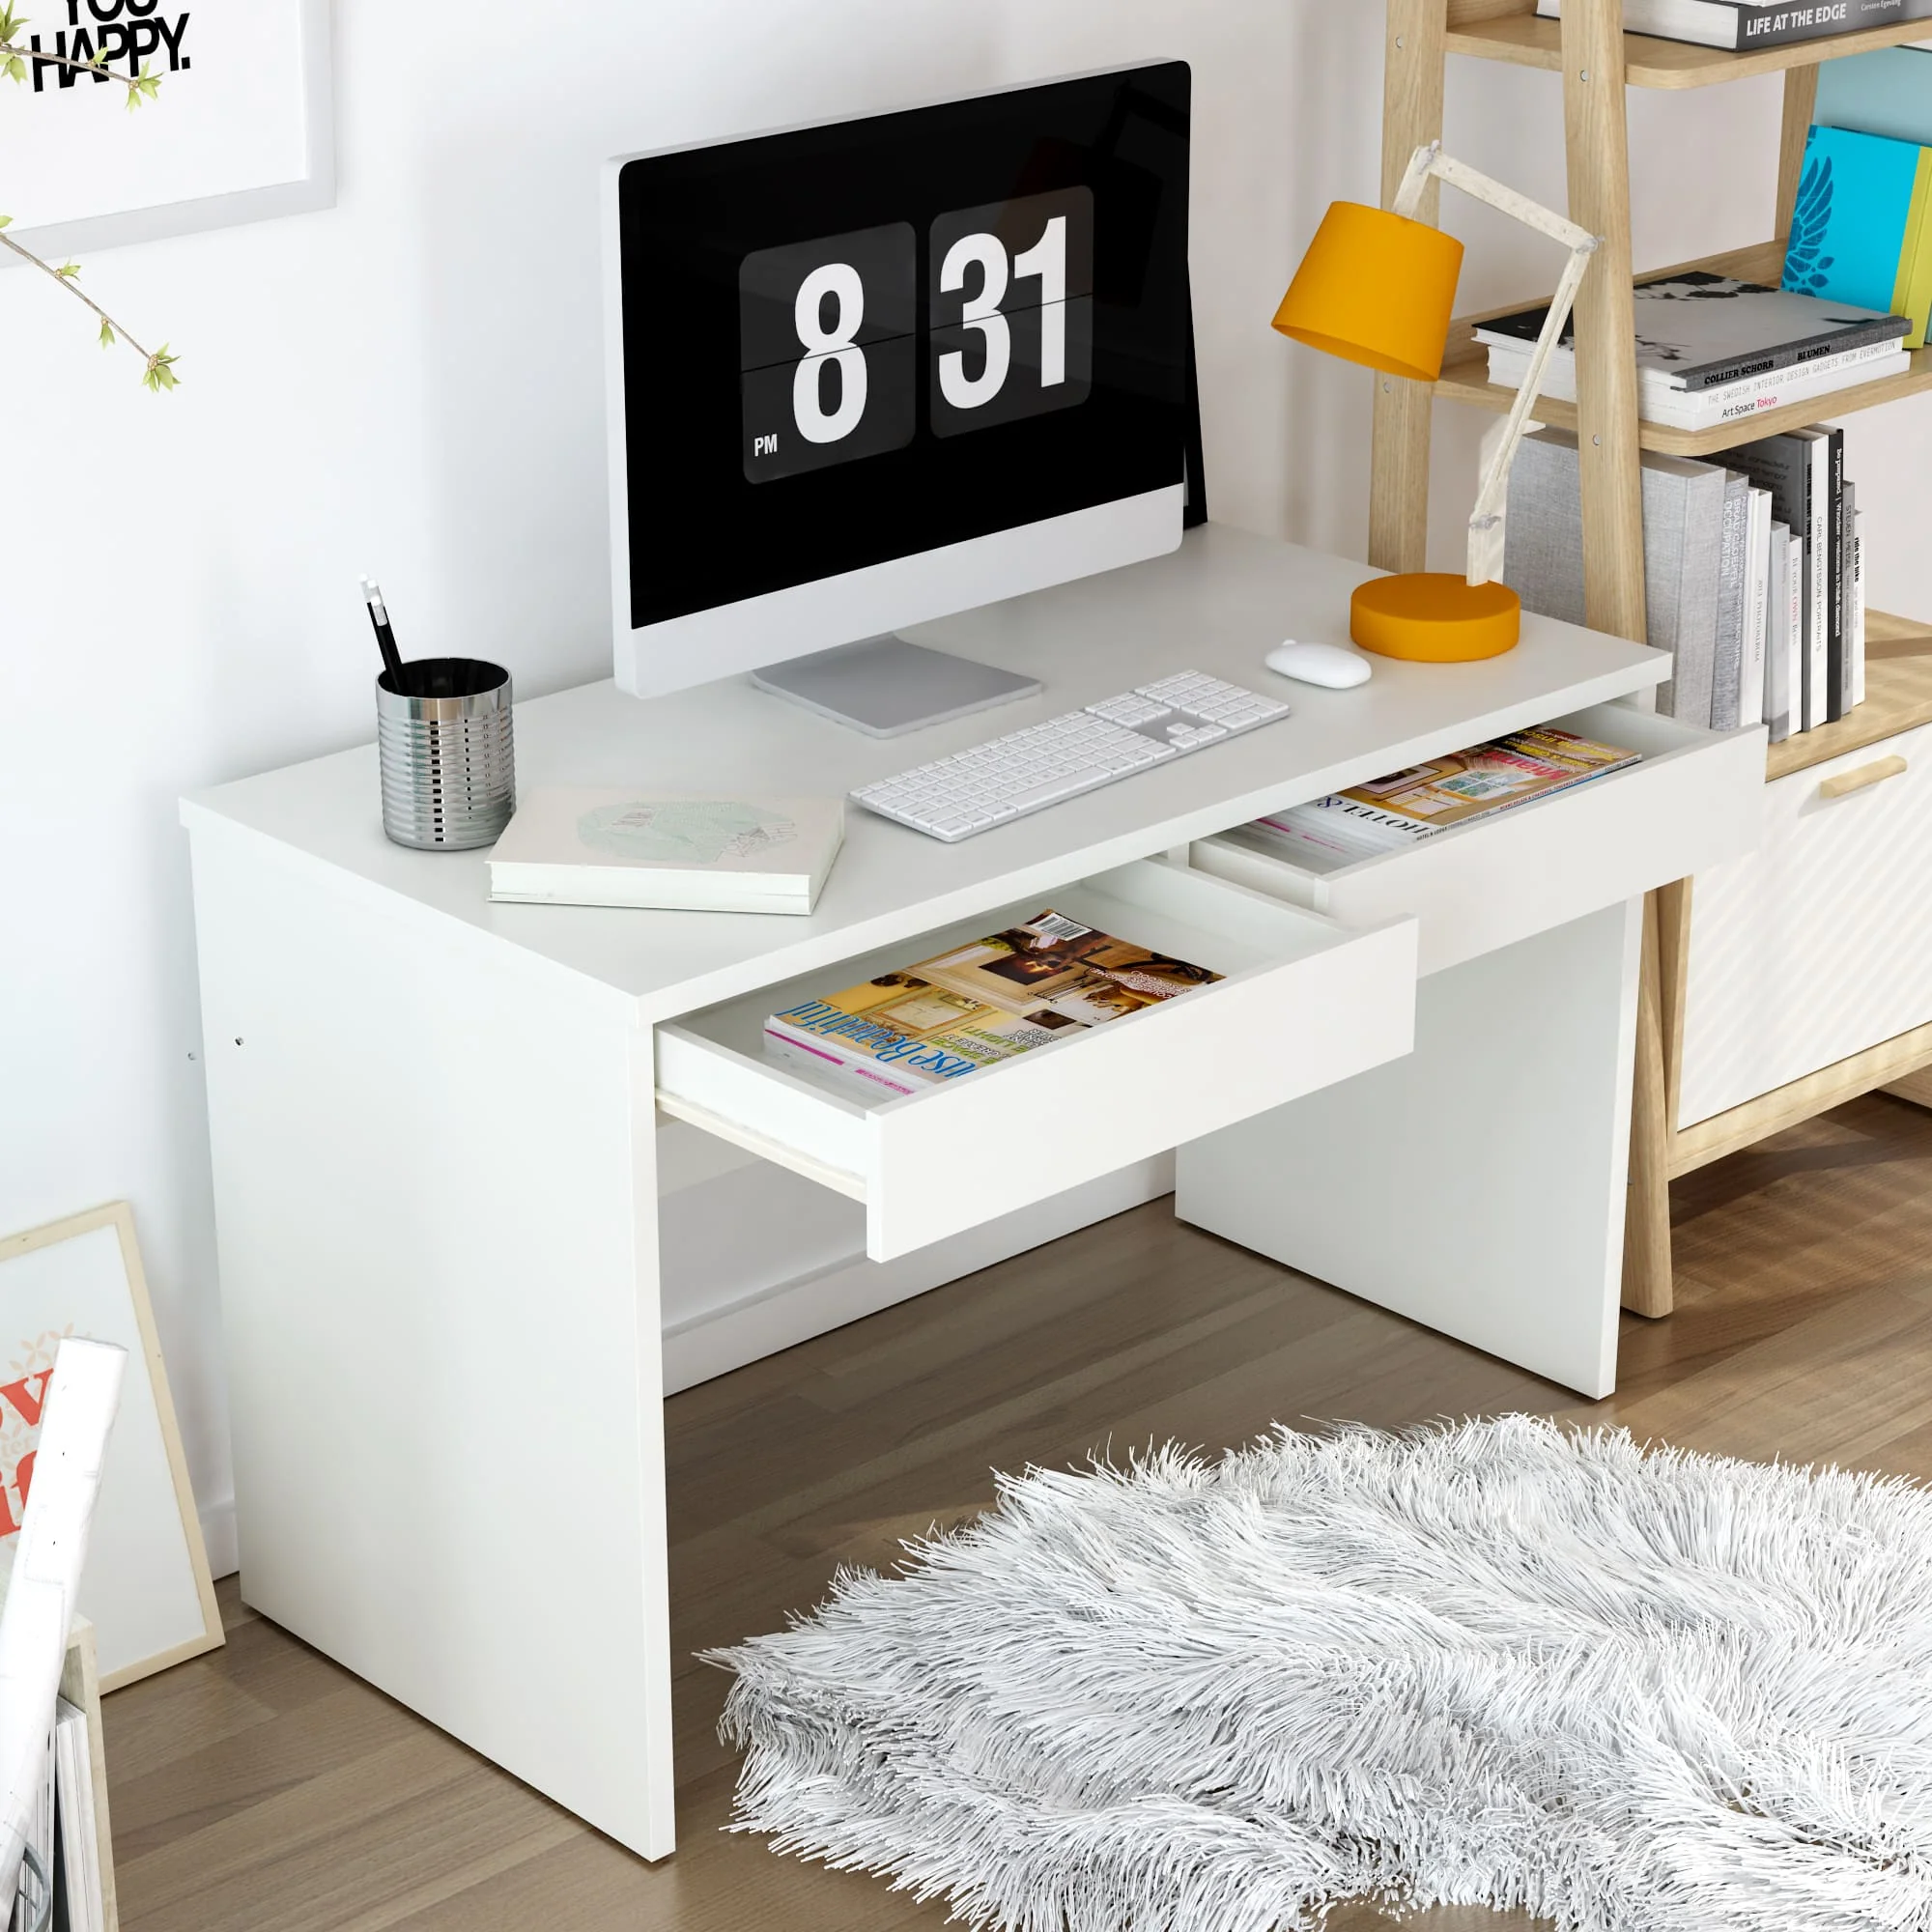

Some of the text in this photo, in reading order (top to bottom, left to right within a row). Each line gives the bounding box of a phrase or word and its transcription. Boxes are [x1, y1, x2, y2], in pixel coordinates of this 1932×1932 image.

[1746, 3, 1847, 37] LIFE AT THE EDGE
[31, 13, 191, 92] HAPPY.
[793, 215, 1065, 443] 8 31
[1797, 345, 1831, 361] BLUMEN
[1704, 359, 1775, 385] COLLIER SCHORR
[1707, 342, 1895, 406] THE SWEDISH INTERIOR DESIGN GADGETS FROM EVERMOTION
[1721, 395, 1777, 418] Art Space Tokyo
[754, 433, 778, 457] PM
[1732, 497, 1742, 530] BRAD
[1721, 500, 1733, 577] OCCUPATION
[1317, 796, 1343, 809] &
[1343, 803, 1431, 834] HOTEL
[776, 1001, 927, 1063] Beautiful
[960, 1025, 1017, 1048] LIGHT!
[927, 1036, 984, 1060] SPACE!
